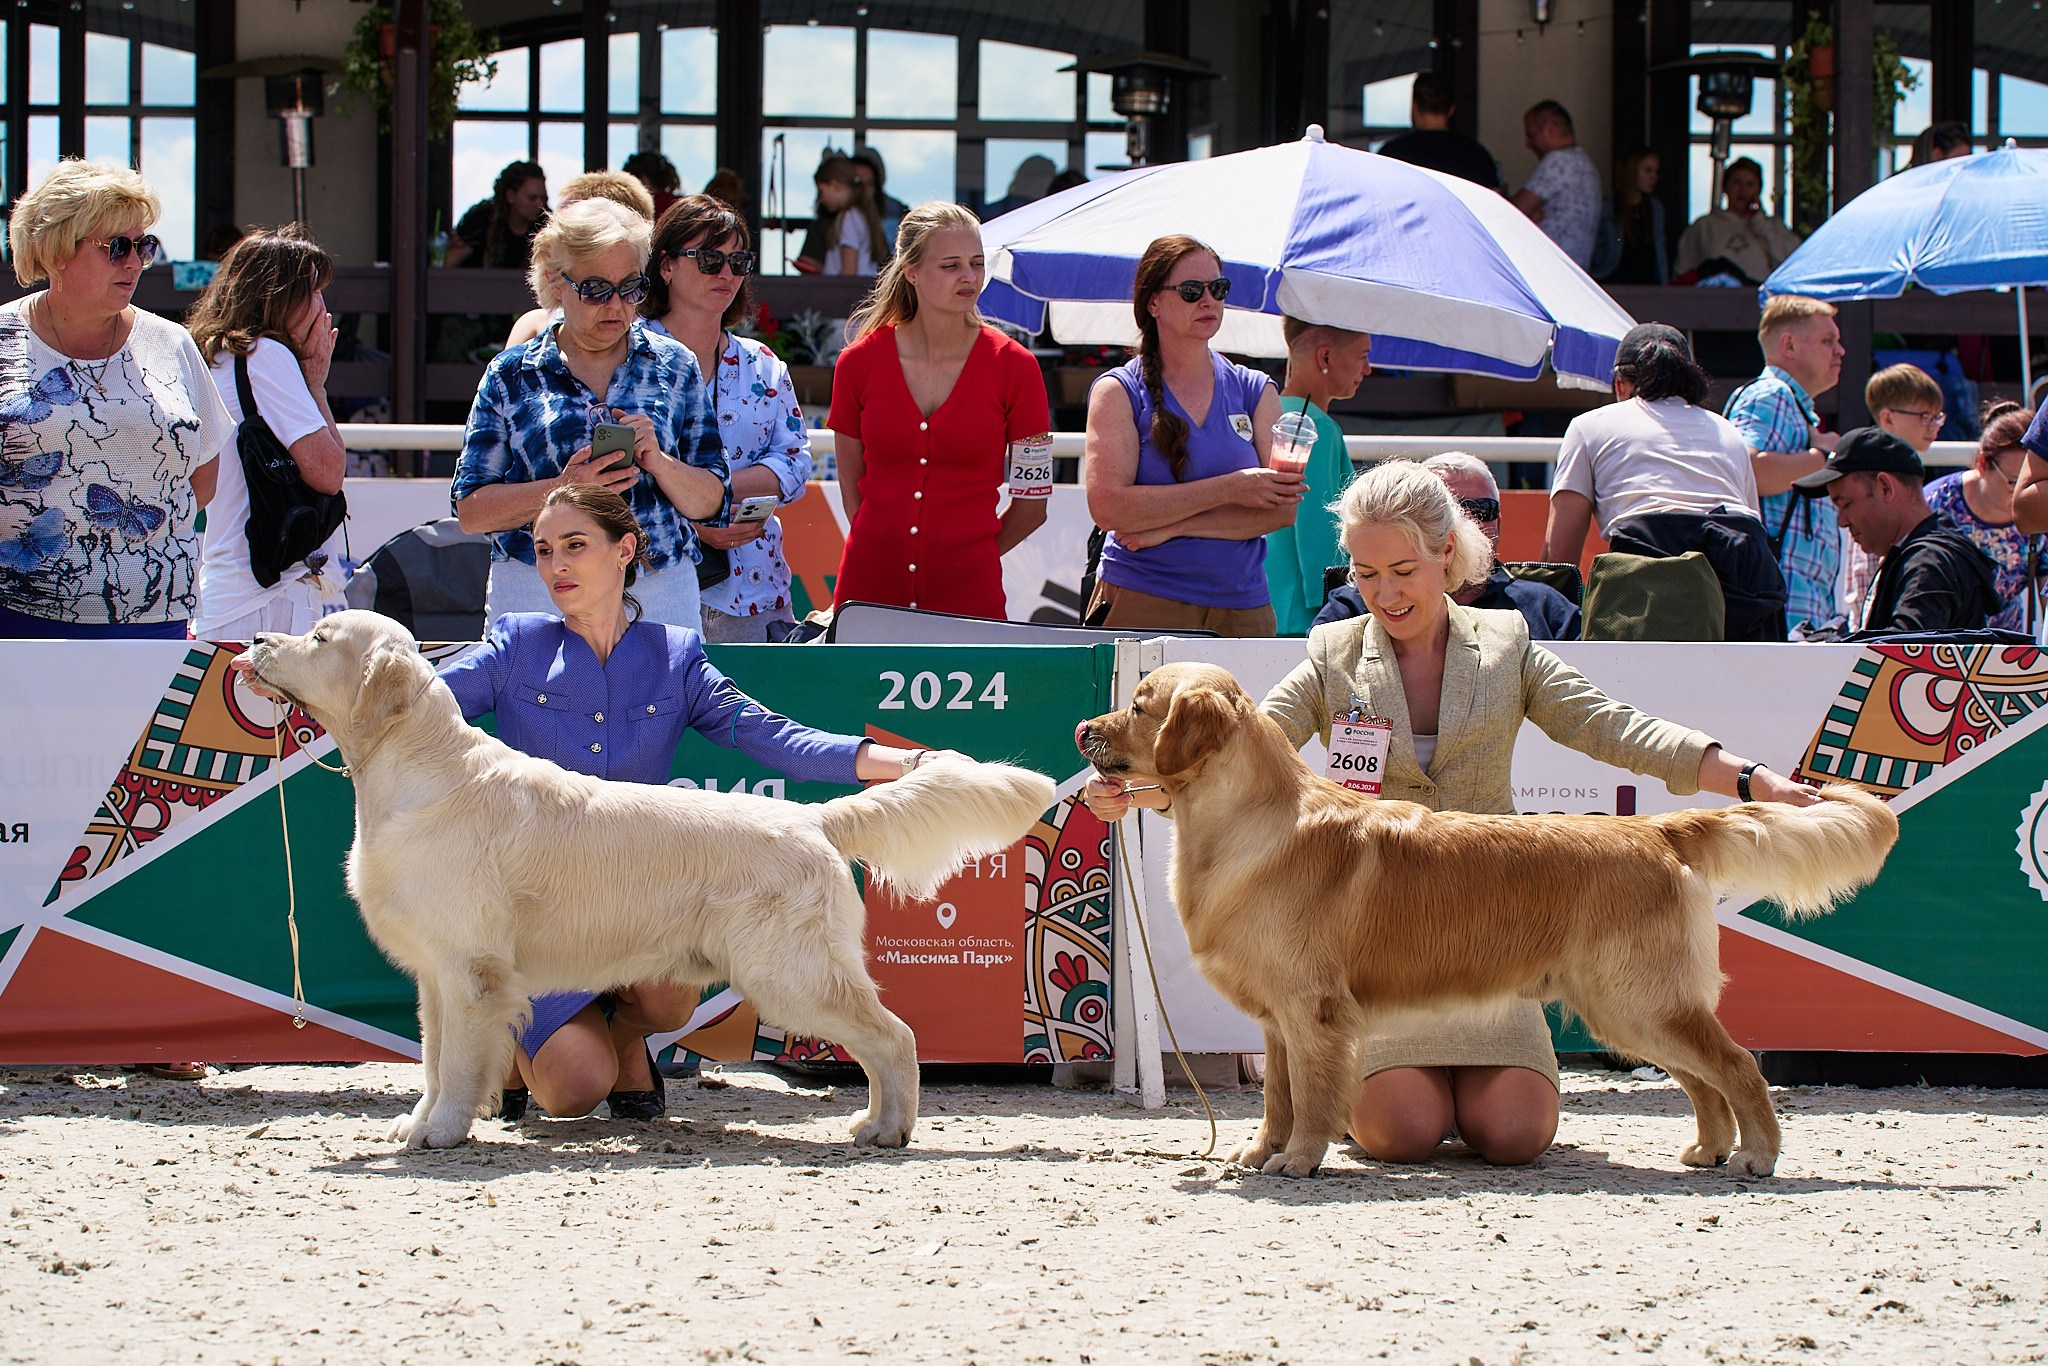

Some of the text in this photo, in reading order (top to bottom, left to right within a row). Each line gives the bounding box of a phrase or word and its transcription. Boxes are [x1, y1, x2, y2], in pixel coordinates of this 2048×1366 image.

[1014, 466, 1050, 480] 2626
[878, 670, 1009, 710] 2024
[1330, 752, 1378, 773] 2608
[1347, 782, 1376, 792] 9.06.2024
[1511, 787, 1599, 798] AMPIONS
[0, 822, 29, 843] ая
[875, 935, 1014, 948] Московская область,
[877, 950, 1013, 968] «Максима Парк»
